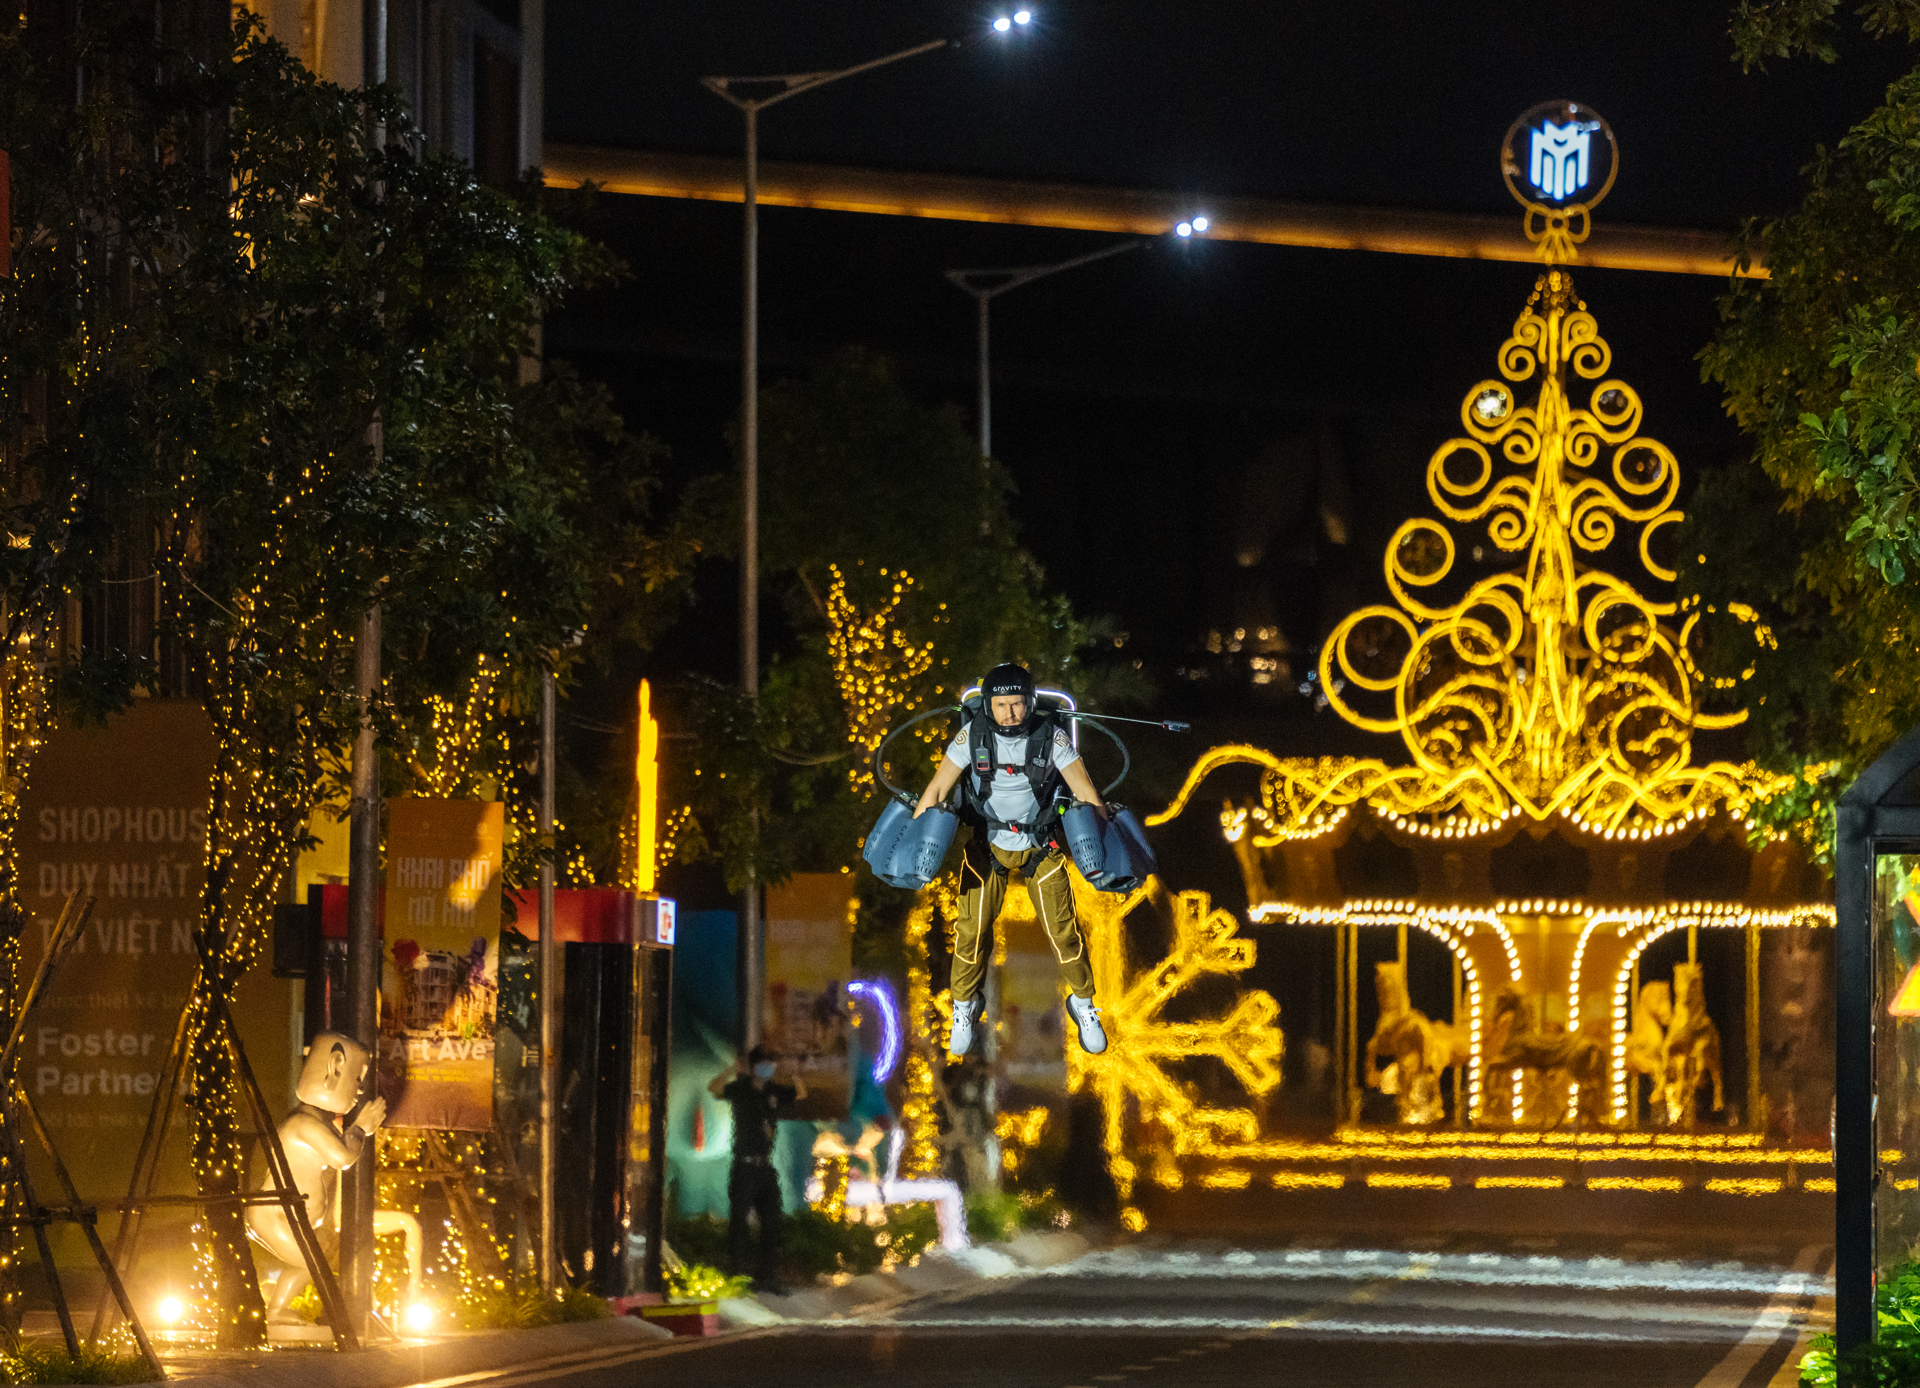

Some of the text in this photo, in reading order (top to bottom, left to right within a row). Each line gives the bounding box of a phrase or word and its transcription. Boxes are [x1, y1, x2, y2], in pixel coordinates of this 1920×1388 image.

[39, 849, 191, 898] DUY NHẤT
[96, 910, 161, 961] VIỆT
[38, 1027, 155, 1056] Foster
[388, 1037, 487, 1061] Art Ave
